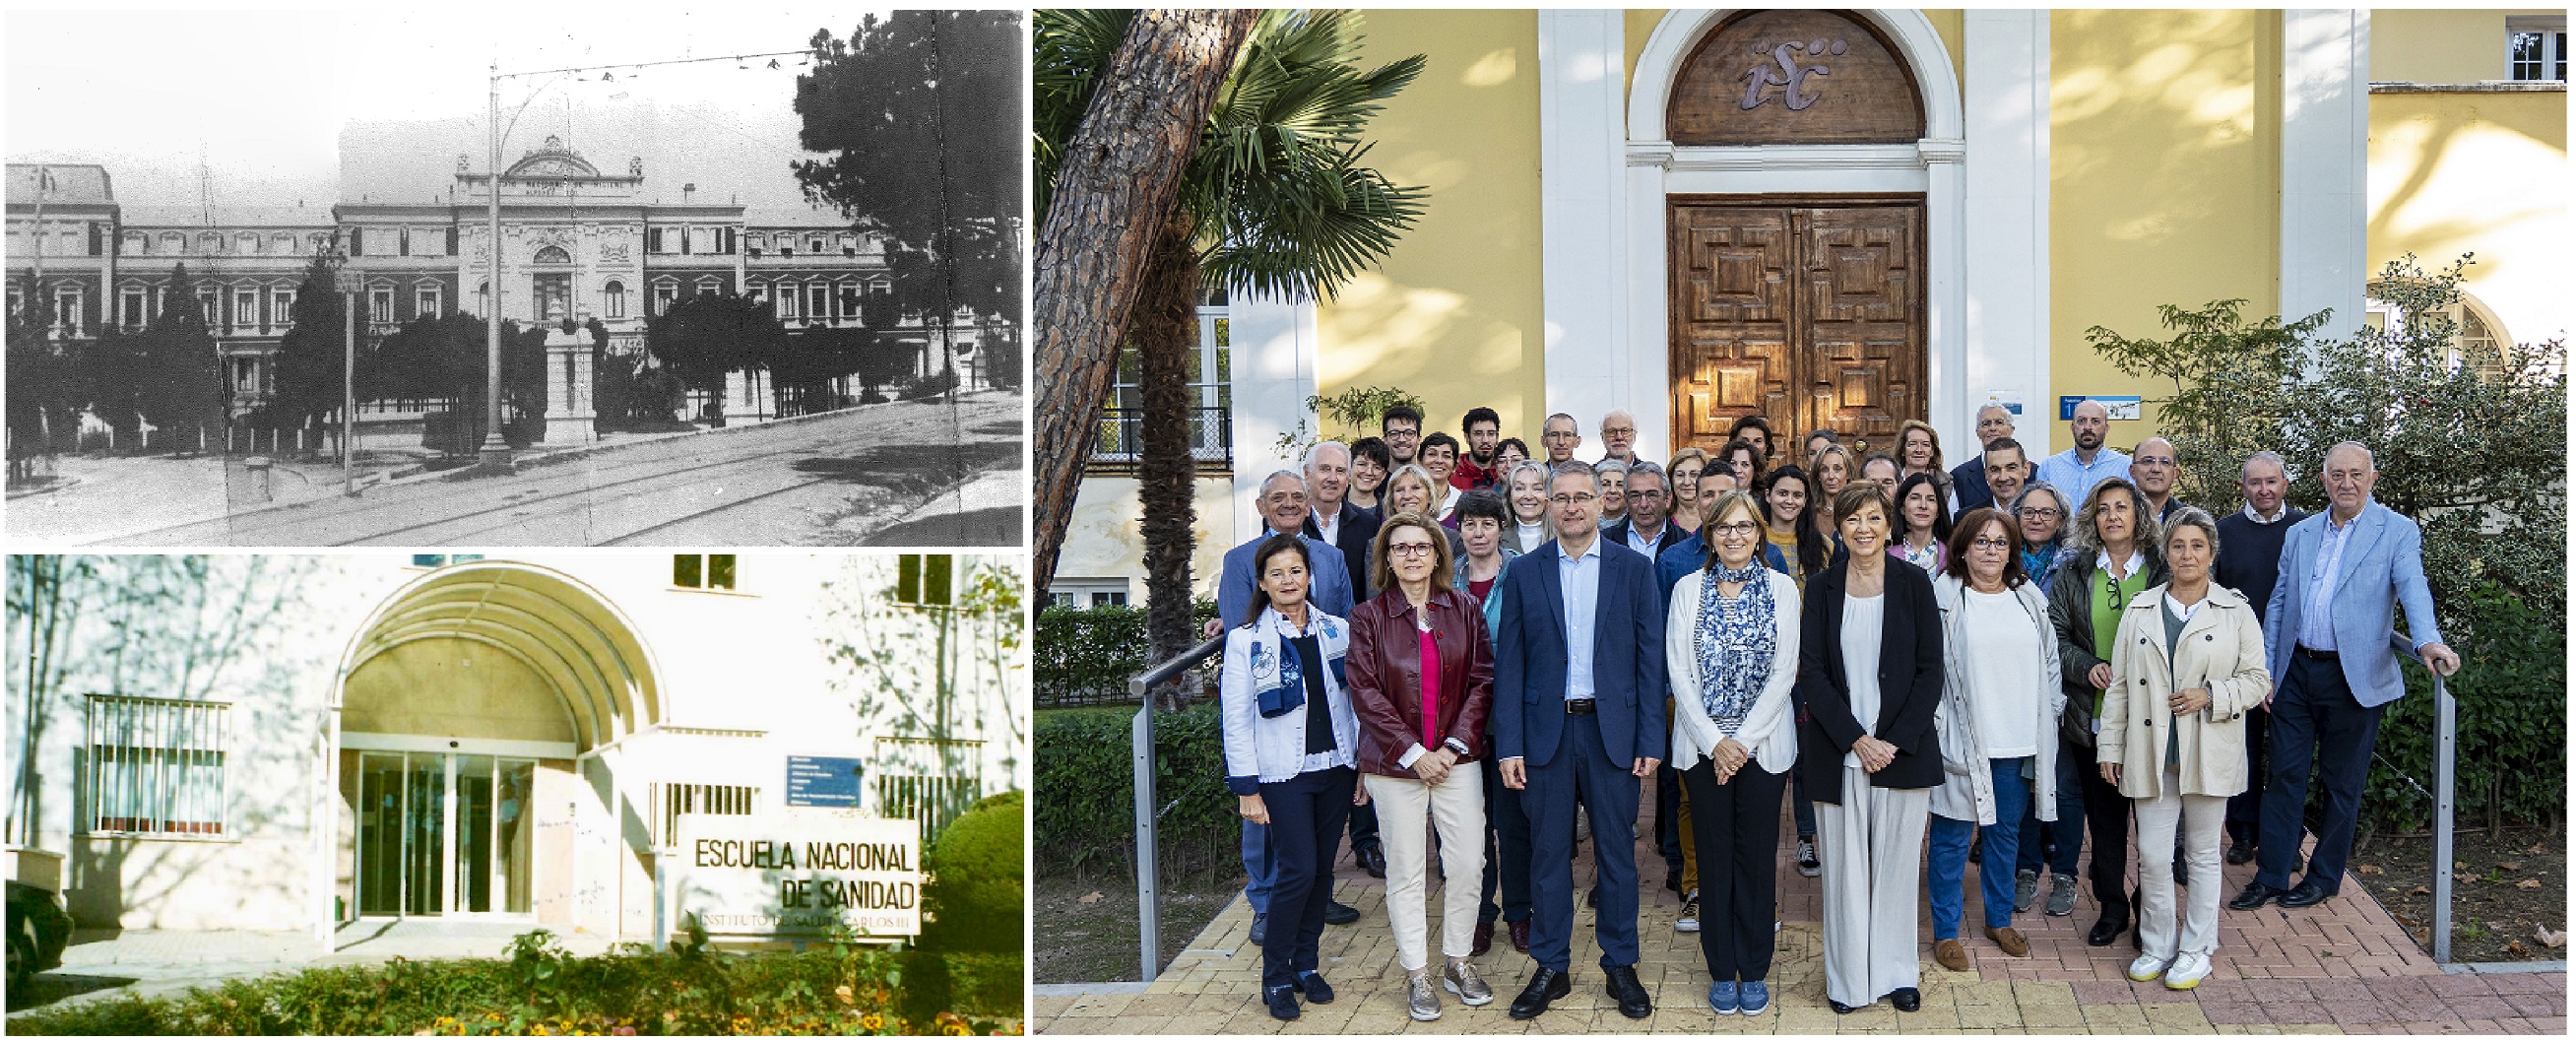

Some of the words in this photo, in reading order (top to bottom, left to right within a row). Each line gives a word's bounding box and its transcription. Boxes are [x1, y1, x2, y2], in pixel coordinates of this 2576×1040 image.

[695, 839, 796, 870] ESCUELA
[805, 841, 914, 872] NACIONAL
[782, 879, 812, 908] DE
[819, 879, 915, 910] SANIDAD
[699, 914, 768, 927] INSTITUTO
[841, 916, 894, 929] CARLOS
[897, 917, 909, 929] III
